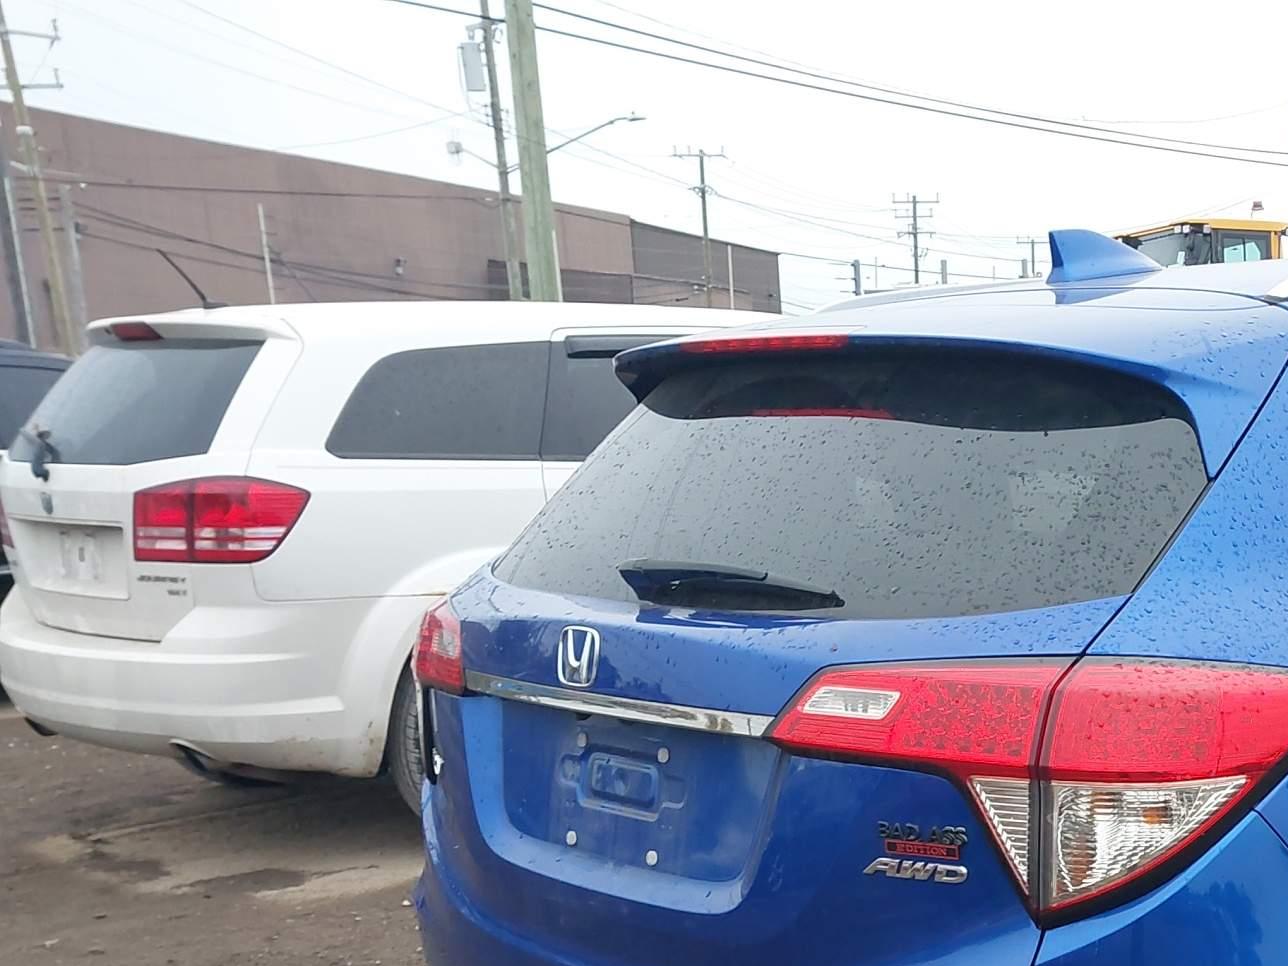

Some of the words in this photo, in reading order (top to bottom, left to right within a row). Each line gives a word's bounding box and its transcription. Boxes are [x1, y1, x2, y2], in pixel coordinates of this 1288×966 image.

[877, 820, 921, 841] BAD
[929, 825, 968, 846] ASS
[894, 842, 948, 857] EDITION
[863, 857, 968, 884] AWD
